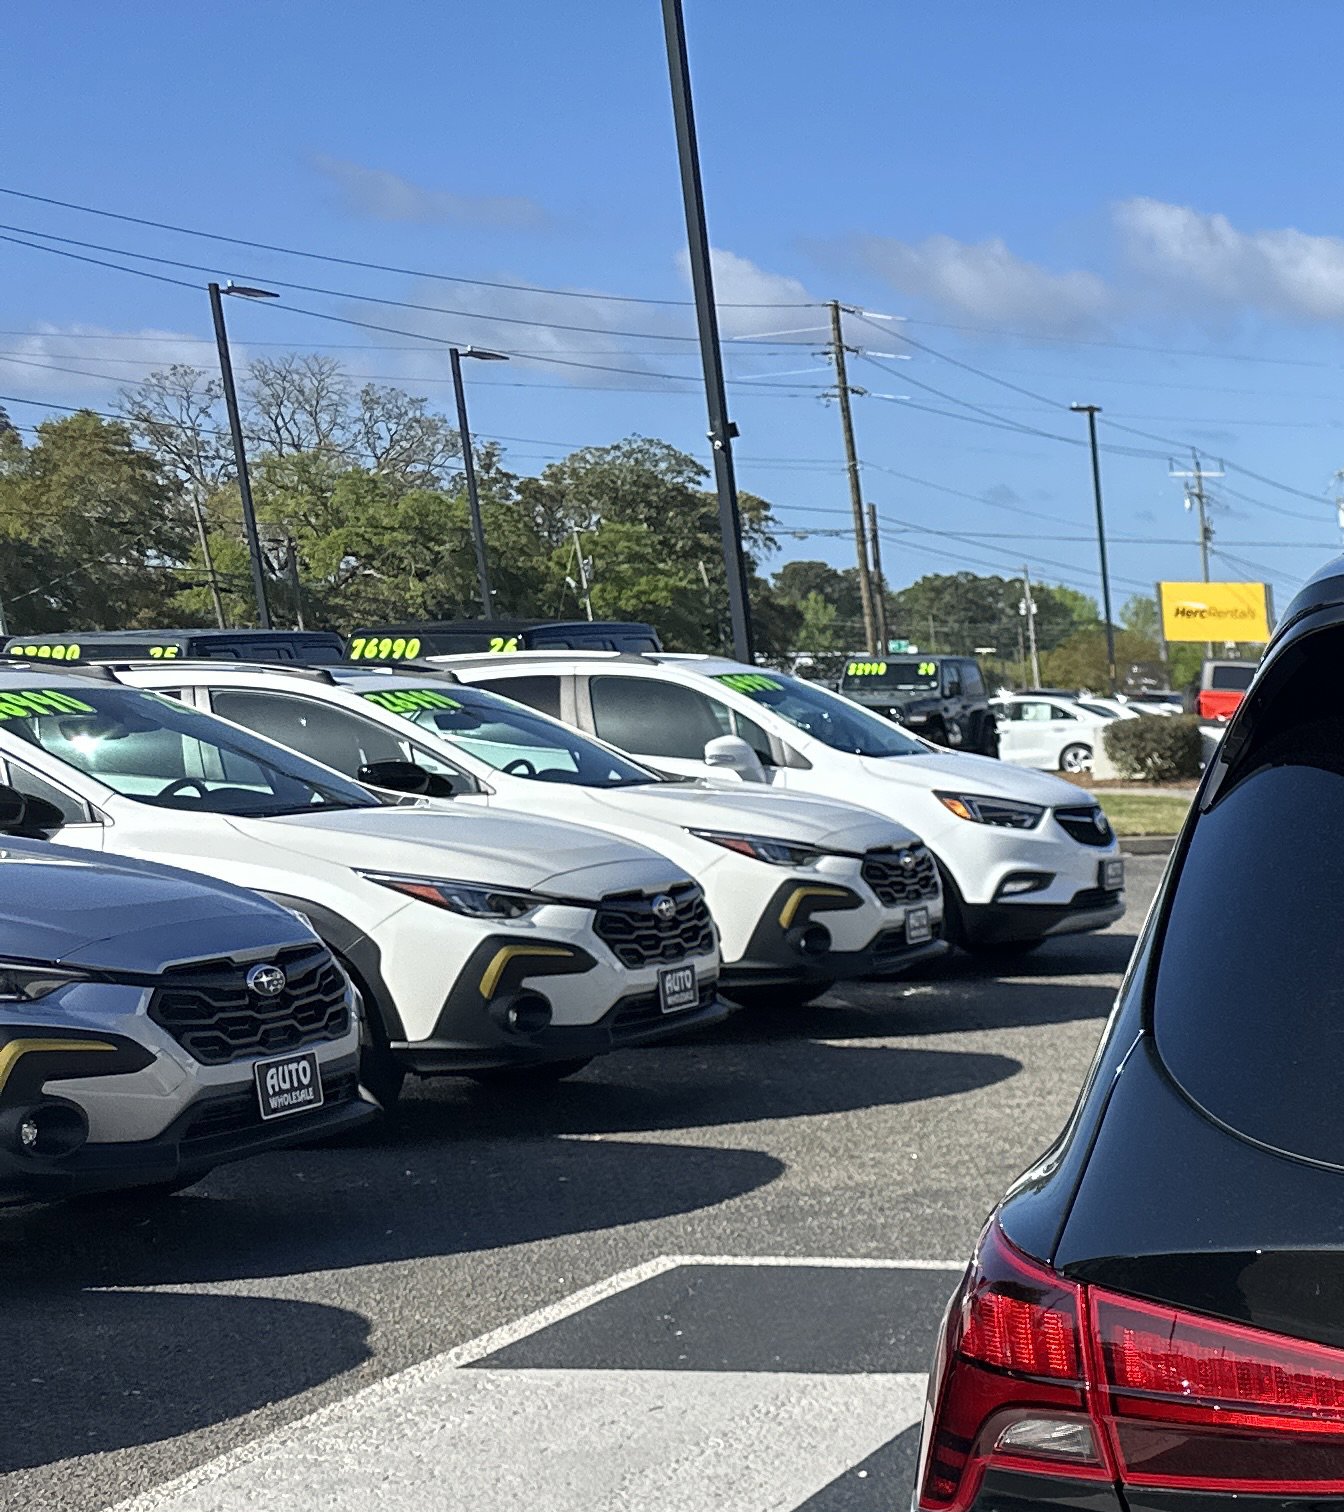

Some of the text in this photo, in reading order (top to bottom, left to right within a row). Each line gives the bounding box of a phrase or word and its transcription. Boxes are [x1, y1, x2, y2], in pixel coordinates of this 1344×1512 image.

[0, 690, 97, 720] 6990
[665, 970, 692, 995] AUTO
[266, 1060, 311, 1096] AUTO
[268, 1087, 315, 1109] WHOLESALE
